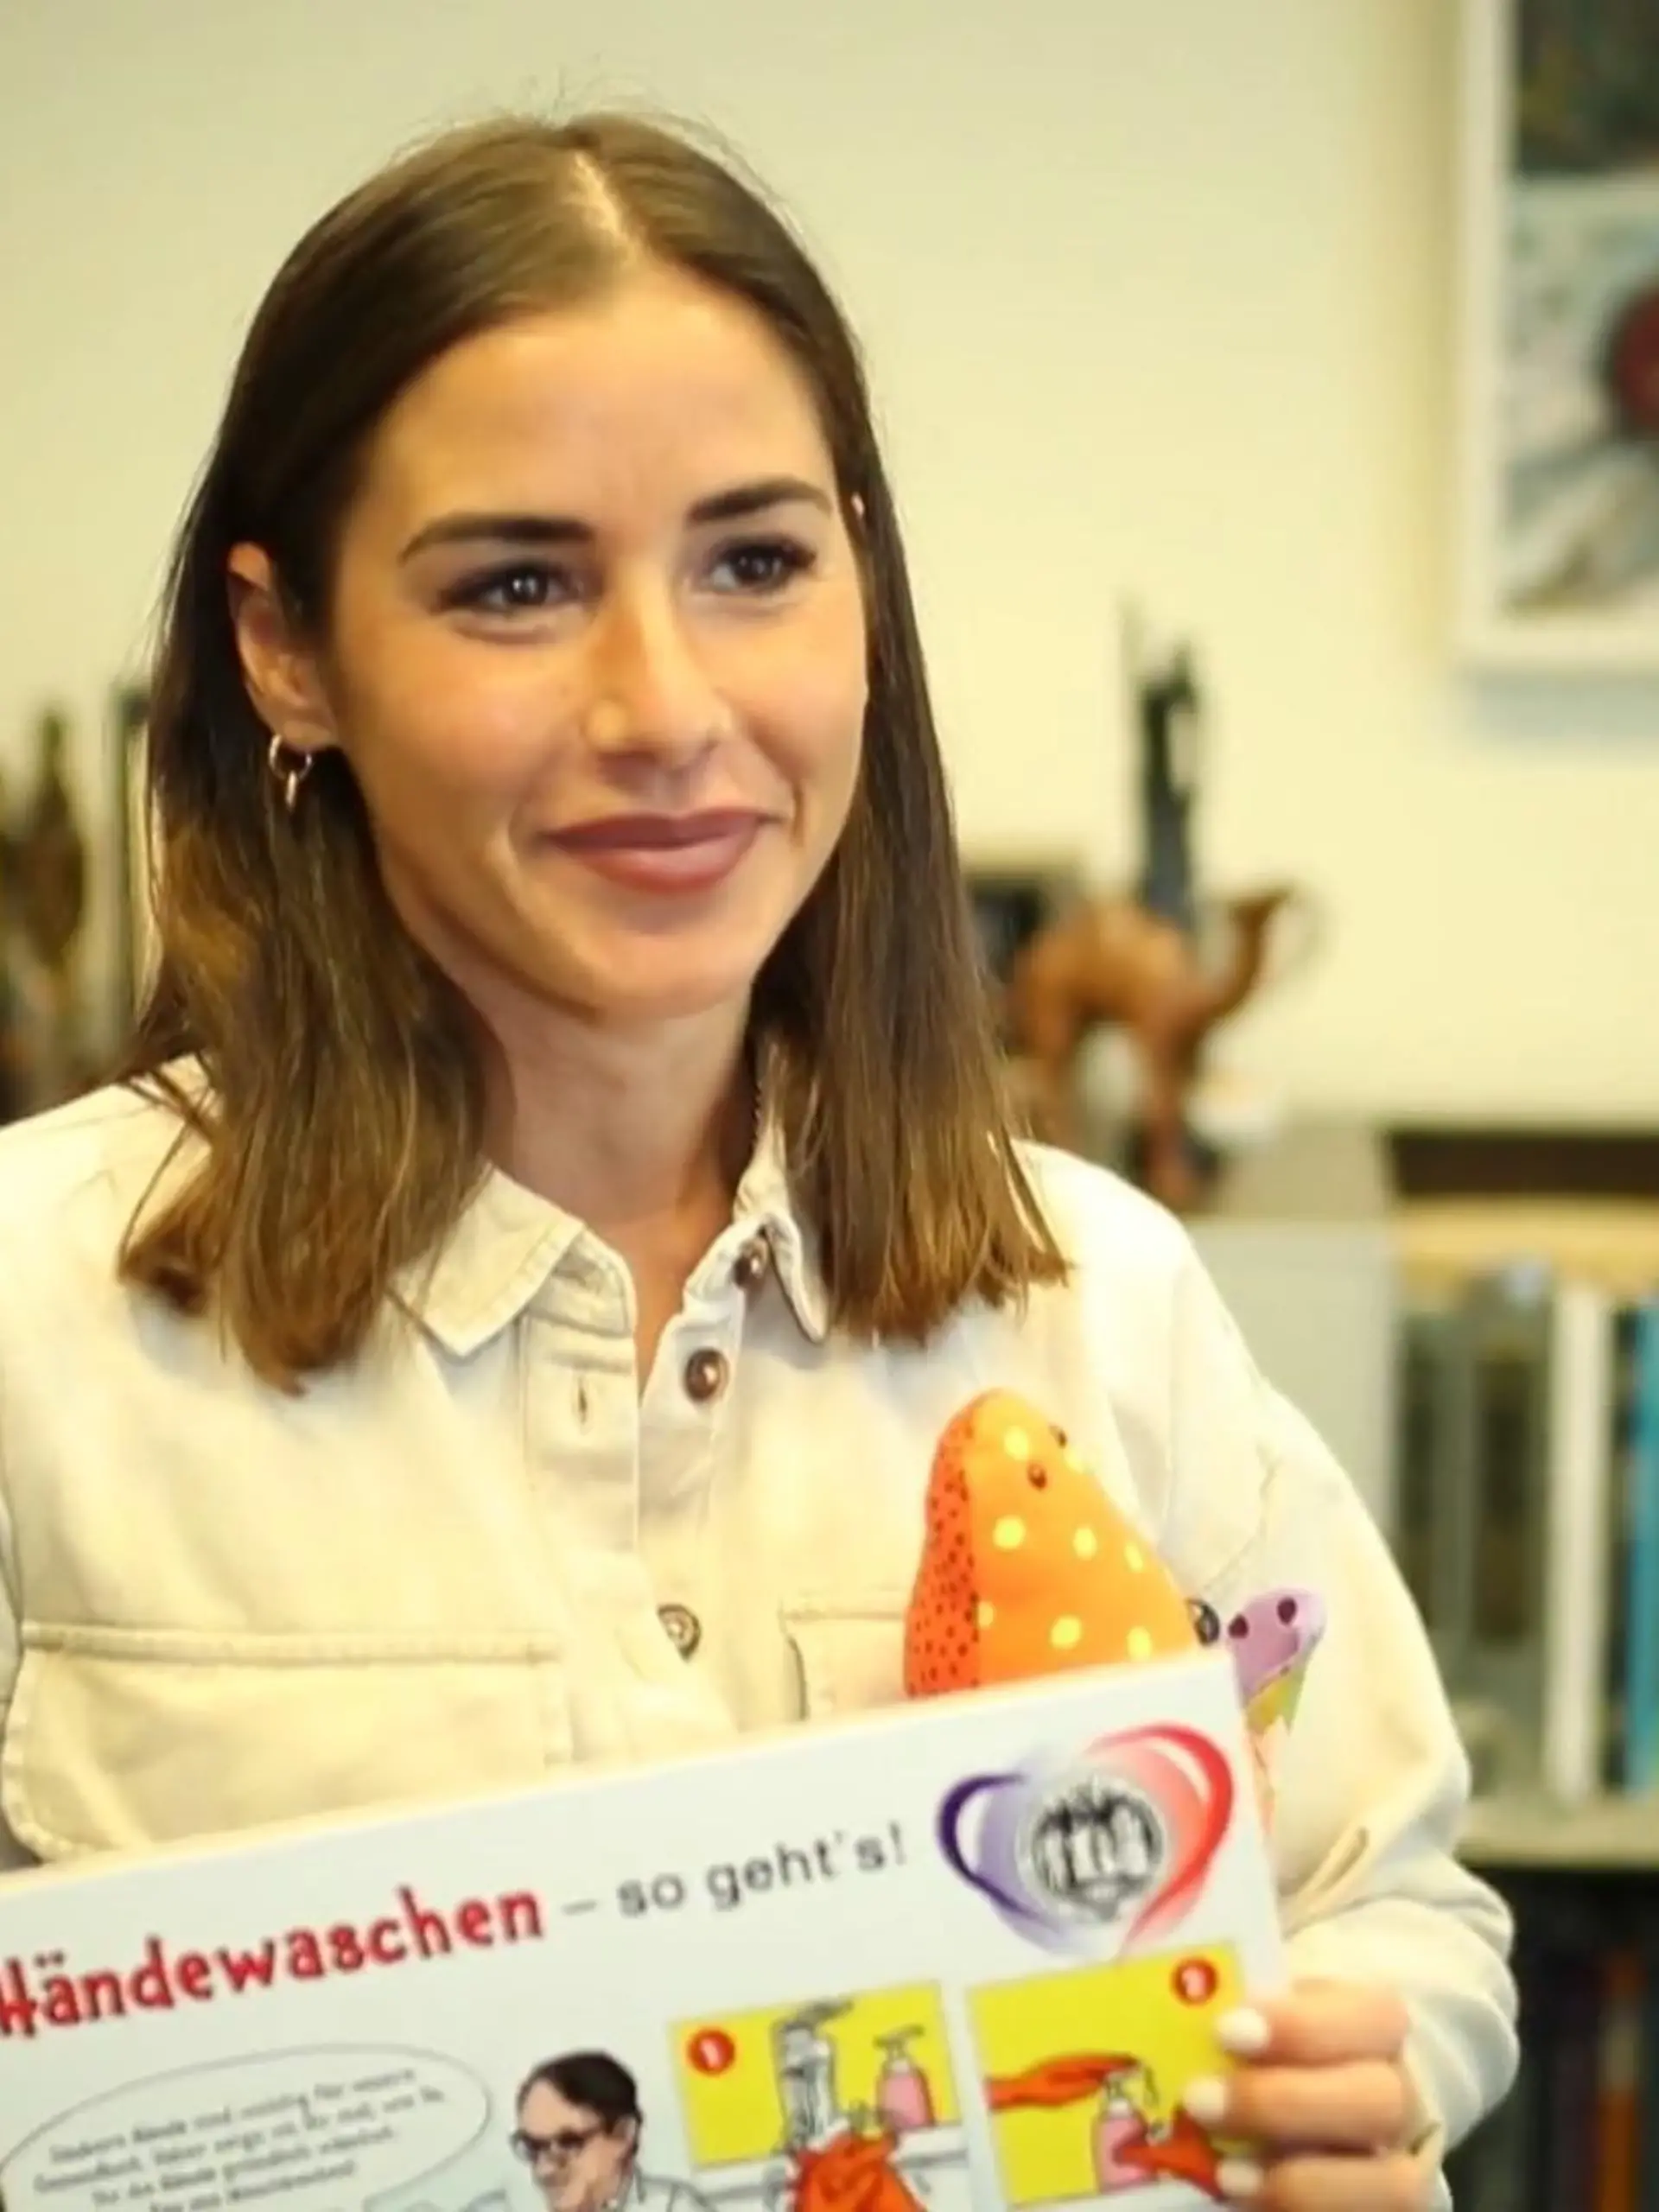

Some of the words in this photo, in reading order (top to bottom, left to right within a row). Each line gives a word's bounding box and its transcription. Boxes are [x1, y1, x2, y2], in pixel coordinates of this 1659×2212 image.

[0, 1885, 543, 2038] Händewaschen
[617, 1873, 685, 1917] so
[706, 1820, 906, 1911] geht's!
